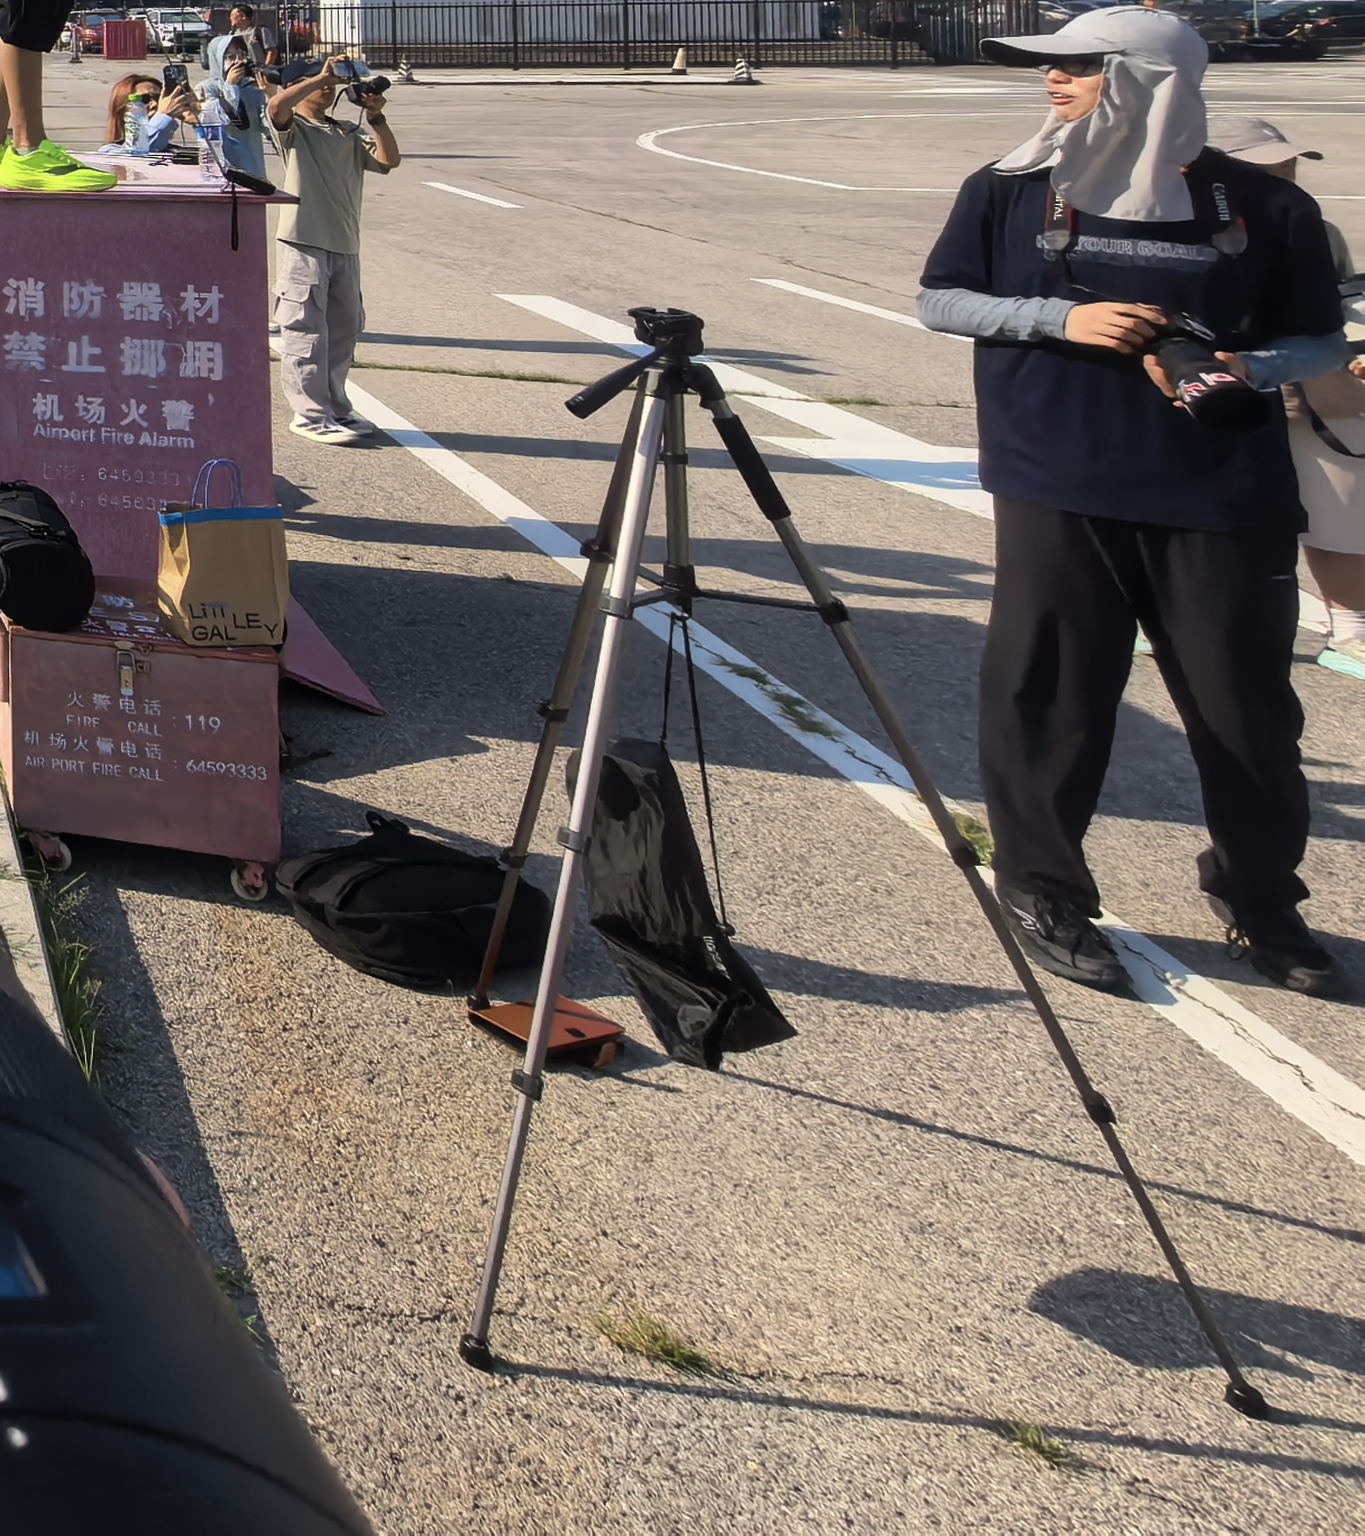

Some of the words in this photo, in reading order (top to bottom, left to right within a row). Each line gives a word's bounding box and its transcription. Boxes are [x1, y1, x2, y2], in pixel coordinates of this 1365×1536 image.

[2, 277, 225, 325] 消防器材
[2, 331, 224, 381] 禁止挪用
[32, 392, 195, 432] 机场火警
[33, 422, 96, 443] Airport
[101, 427, 135, 445] Fire
[138, 431, 195, 449] Alarm
[67, 690, 162, 716] 火警电话
[66, 714, 100, 728] FIRE
[127, 720, 163, 738] CALL
[23, 730, 162, 760] 机场火警电话
[25, 755, 45, 769] AIR
[51, 757, 85, 774] PORT
[92, 762, 122, 778] FIRE
[129, 766, 164, 782] CALL
